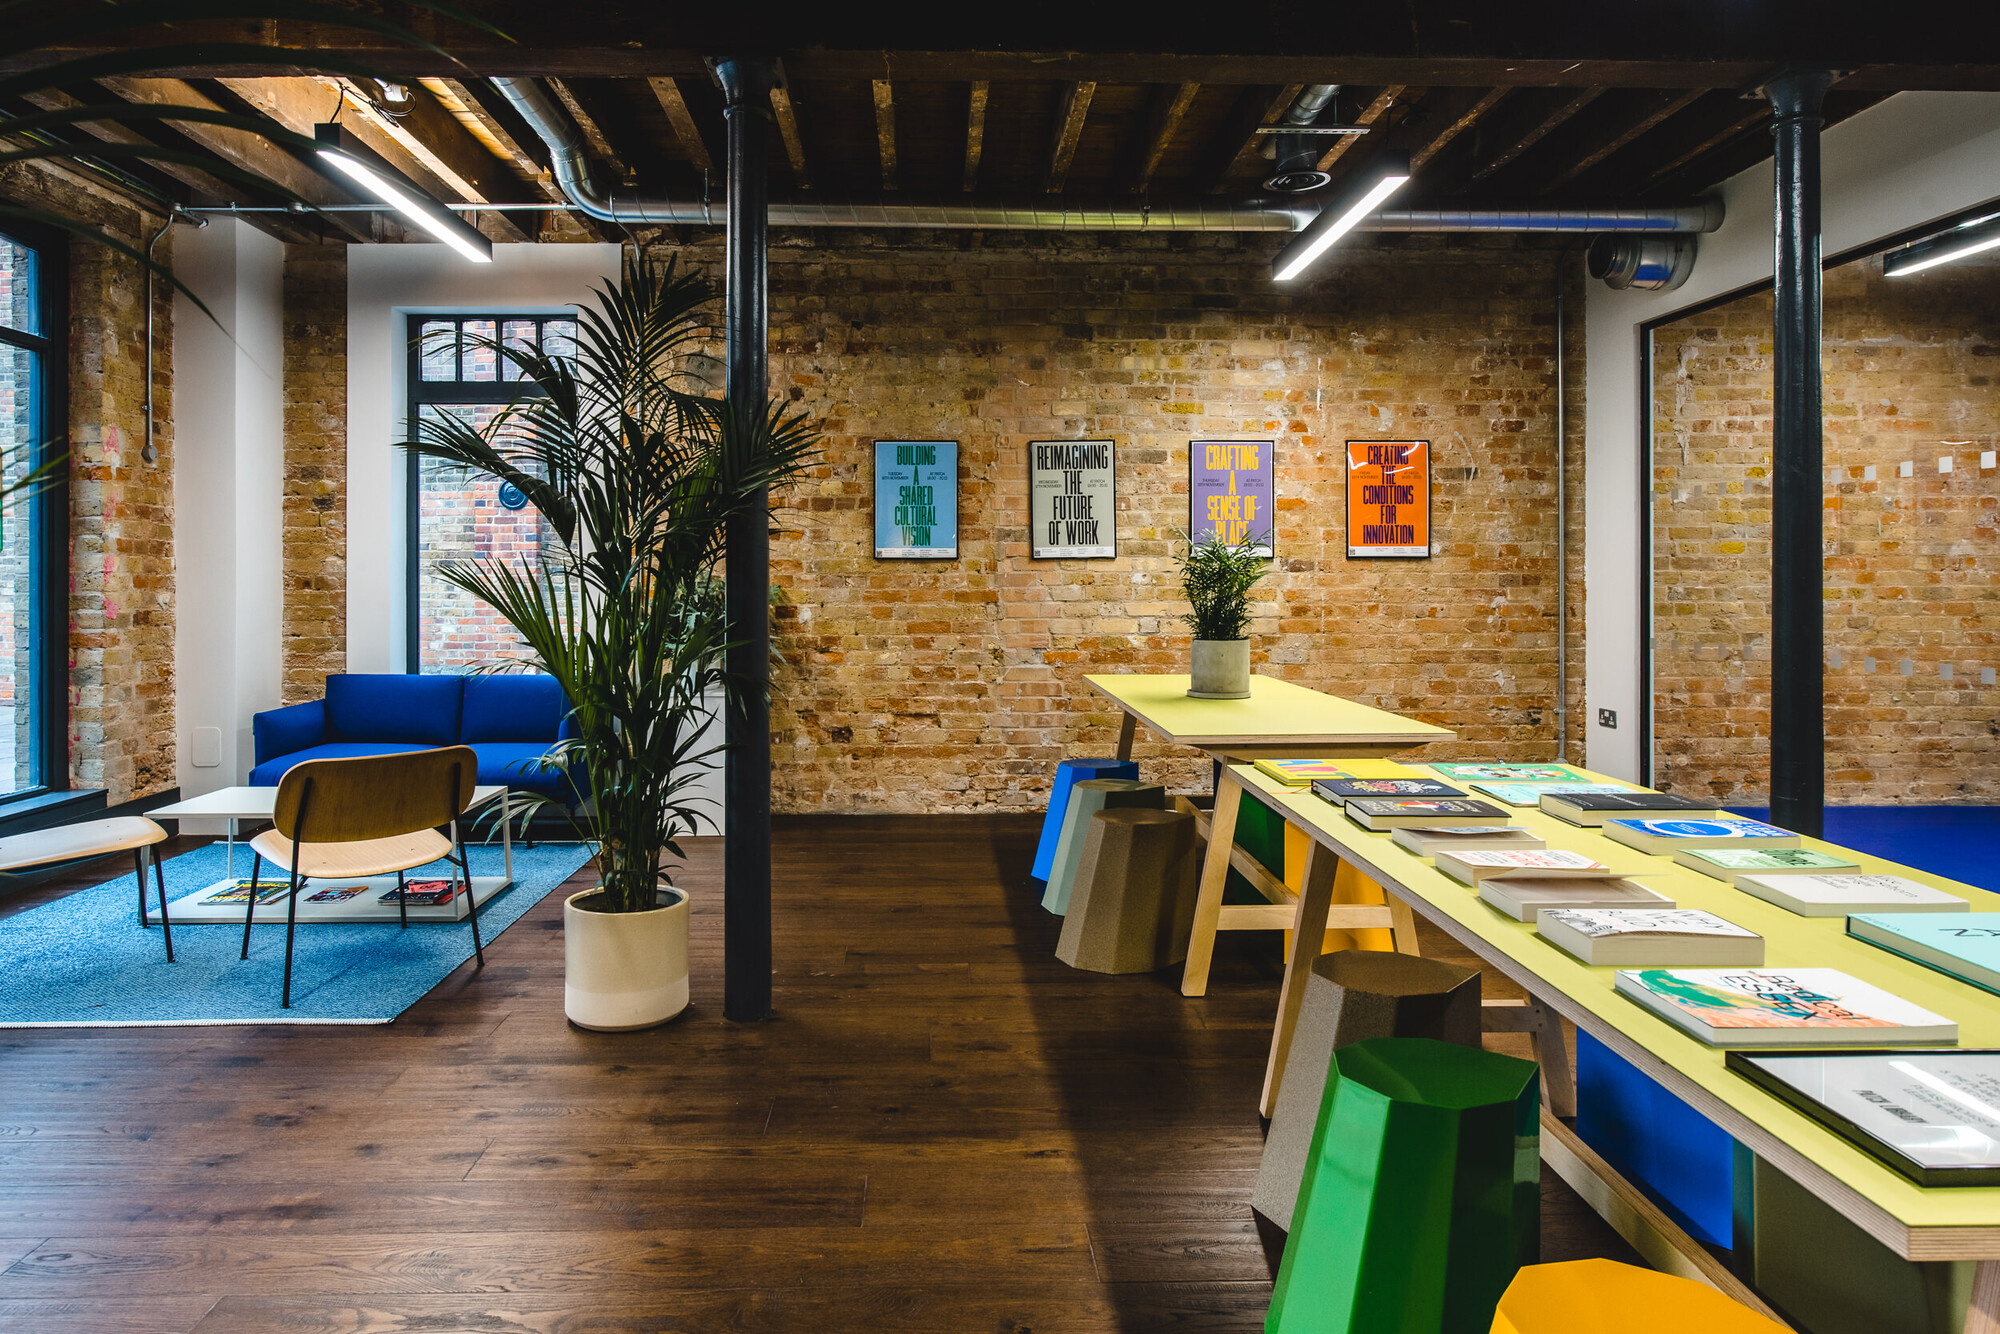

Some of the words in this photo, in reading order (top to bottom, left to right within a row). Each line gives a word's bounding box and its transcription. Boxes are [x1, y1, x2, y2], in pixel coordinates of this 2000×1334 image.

[897, 445, 936, 466] BUILDING
[1037, 445, 1108, 470] REIMAGINING
[1206, 445, 1259, 470] CRAFTING
[1368, 446, 1408, 465] CREATING
[913, 466, 920, 485] A
[1063, 470, 1083, 495] THE
[1229, 470, 1236, 495] A
[1381, 466, 1396, 485] THE
[899, 486, 933, 506] SHARED
[1363, 485, 1414, 505] CONDITIONS
[894, 506, 938, 526] CULTURAL
[1053, 495, 1094, 520] FUTURE
[1207, 496, 1241, 521] SENSE
[1244, 496, 1258, 521] OF
[1380, 505, 1396, 524] FOR
[902, 526, 931, 546] VISION
[1049, 521, 1062, 546] OF
[1066, 520, 1099, 545] WORK
[1216, 521, 1249, 546] PLACE
[1363, 525, 1414, 544] INNOVATION
[1267, 759, 1357, 780] ART
[1645, 912, 1688, 926] WE
[1672, 910, 1733, 931] WHY
[1724, 975, 1831, 1020] ESSEX
[1759, 975, 1871, 1020] Radical
[1851, 1090, 1892, 1103] PATCH
[1878, 1104, 1930, 1123] LIBRARY
